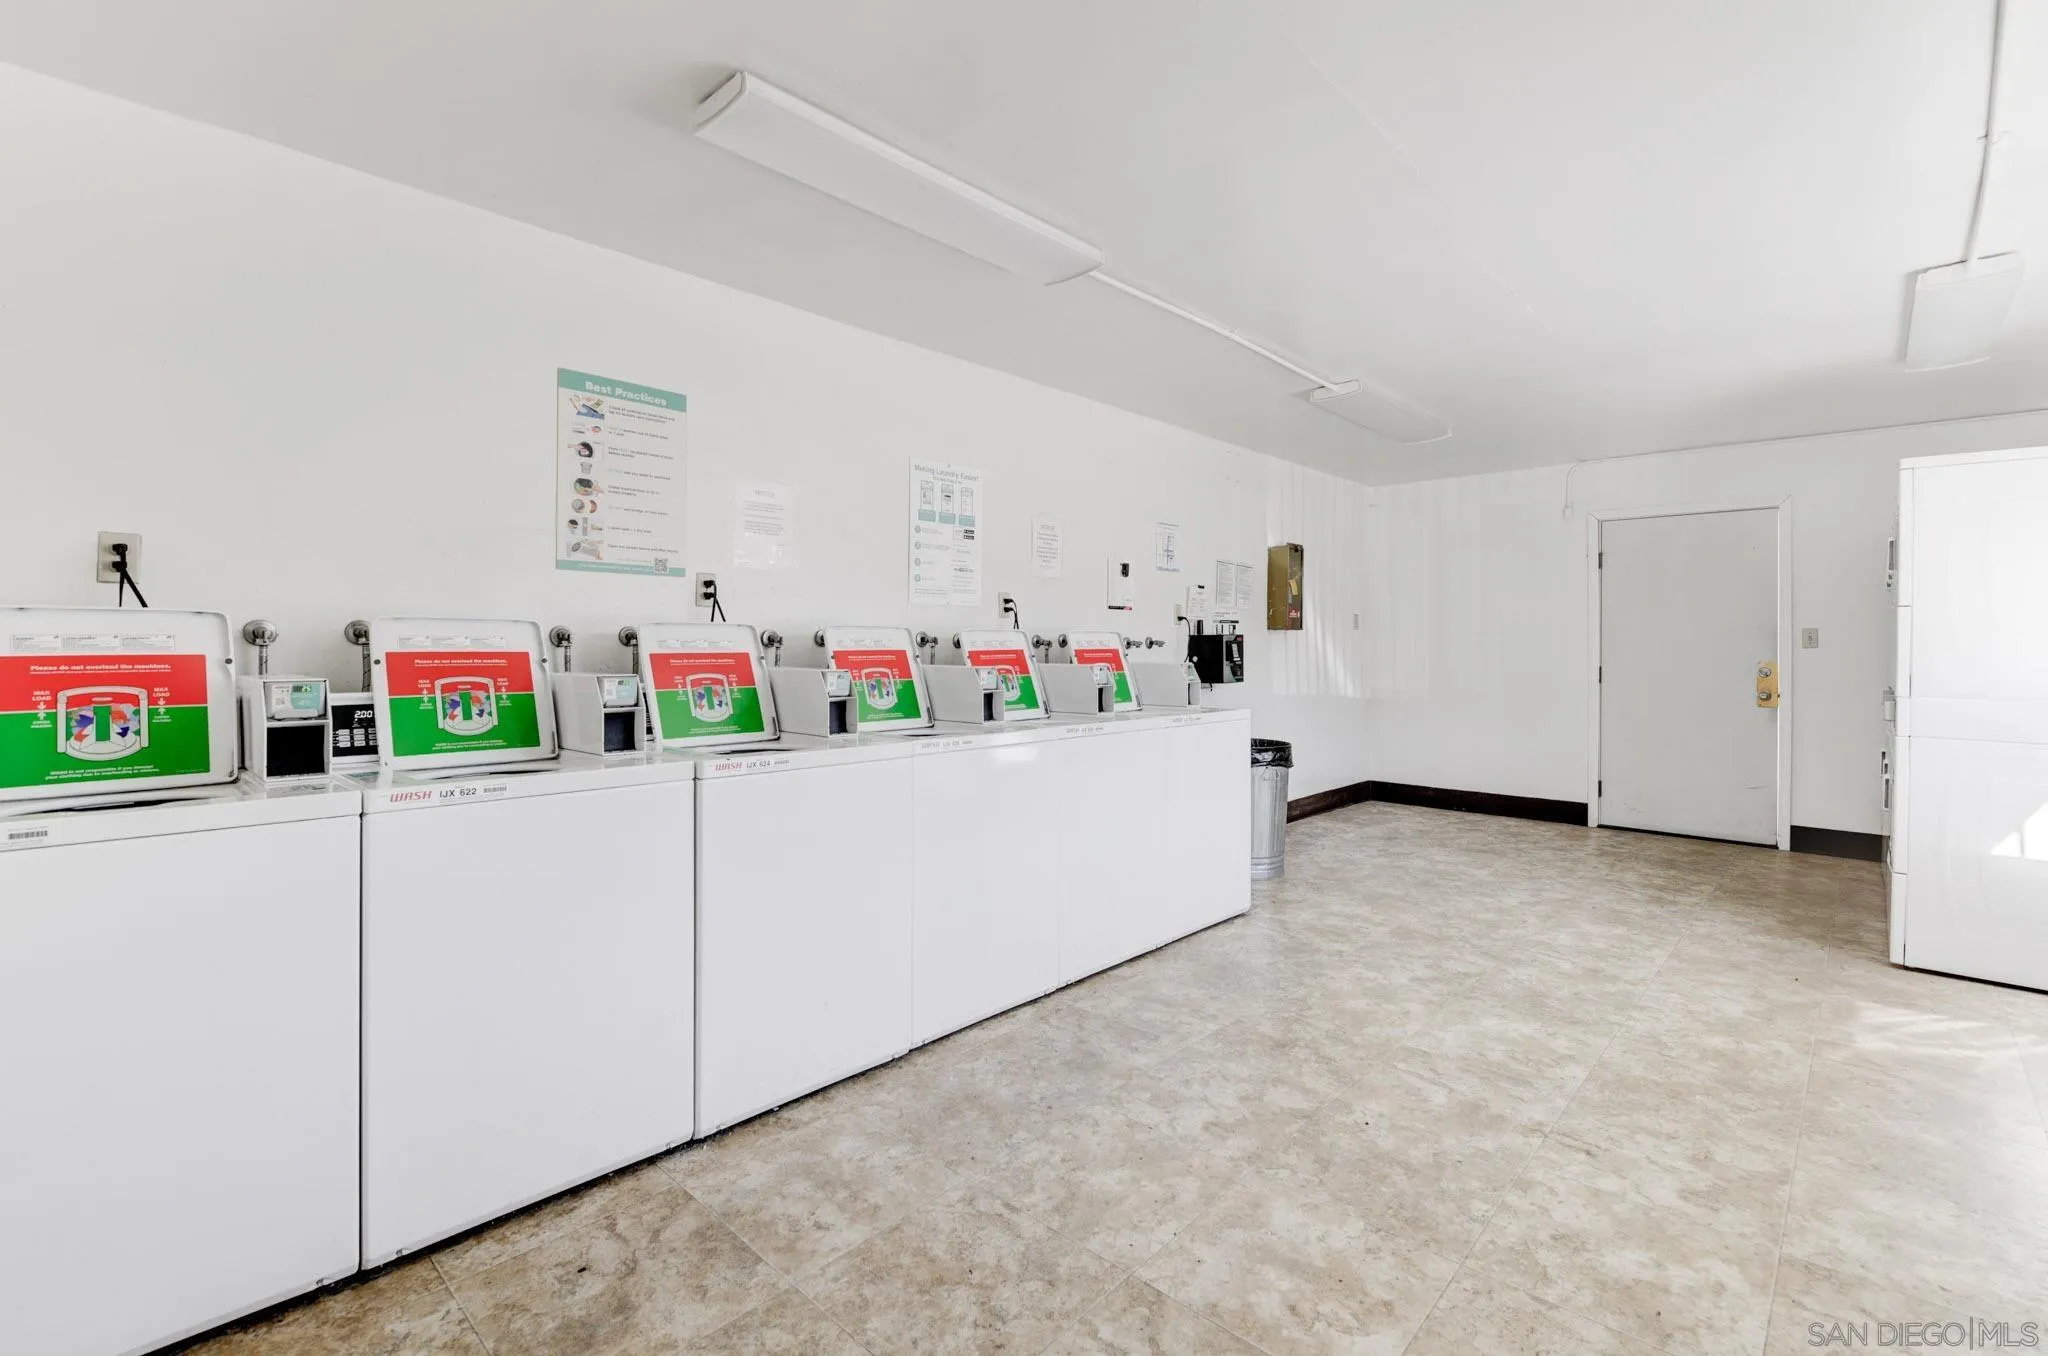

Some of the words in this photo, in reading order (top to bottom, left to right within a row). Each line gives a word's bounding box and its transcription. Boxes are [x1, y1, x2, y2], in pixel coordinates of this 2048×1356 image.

[585, 381, 612, 395] Best
[615, 387, 667, 407] Practices
[914, 463, 936, 475] Making
[936, 467, 960, 480] Laundry
[715, 761, 743, 771] WASH
[390, 790, 432, 803] WASH
[459, 787, 477, 796] 622
